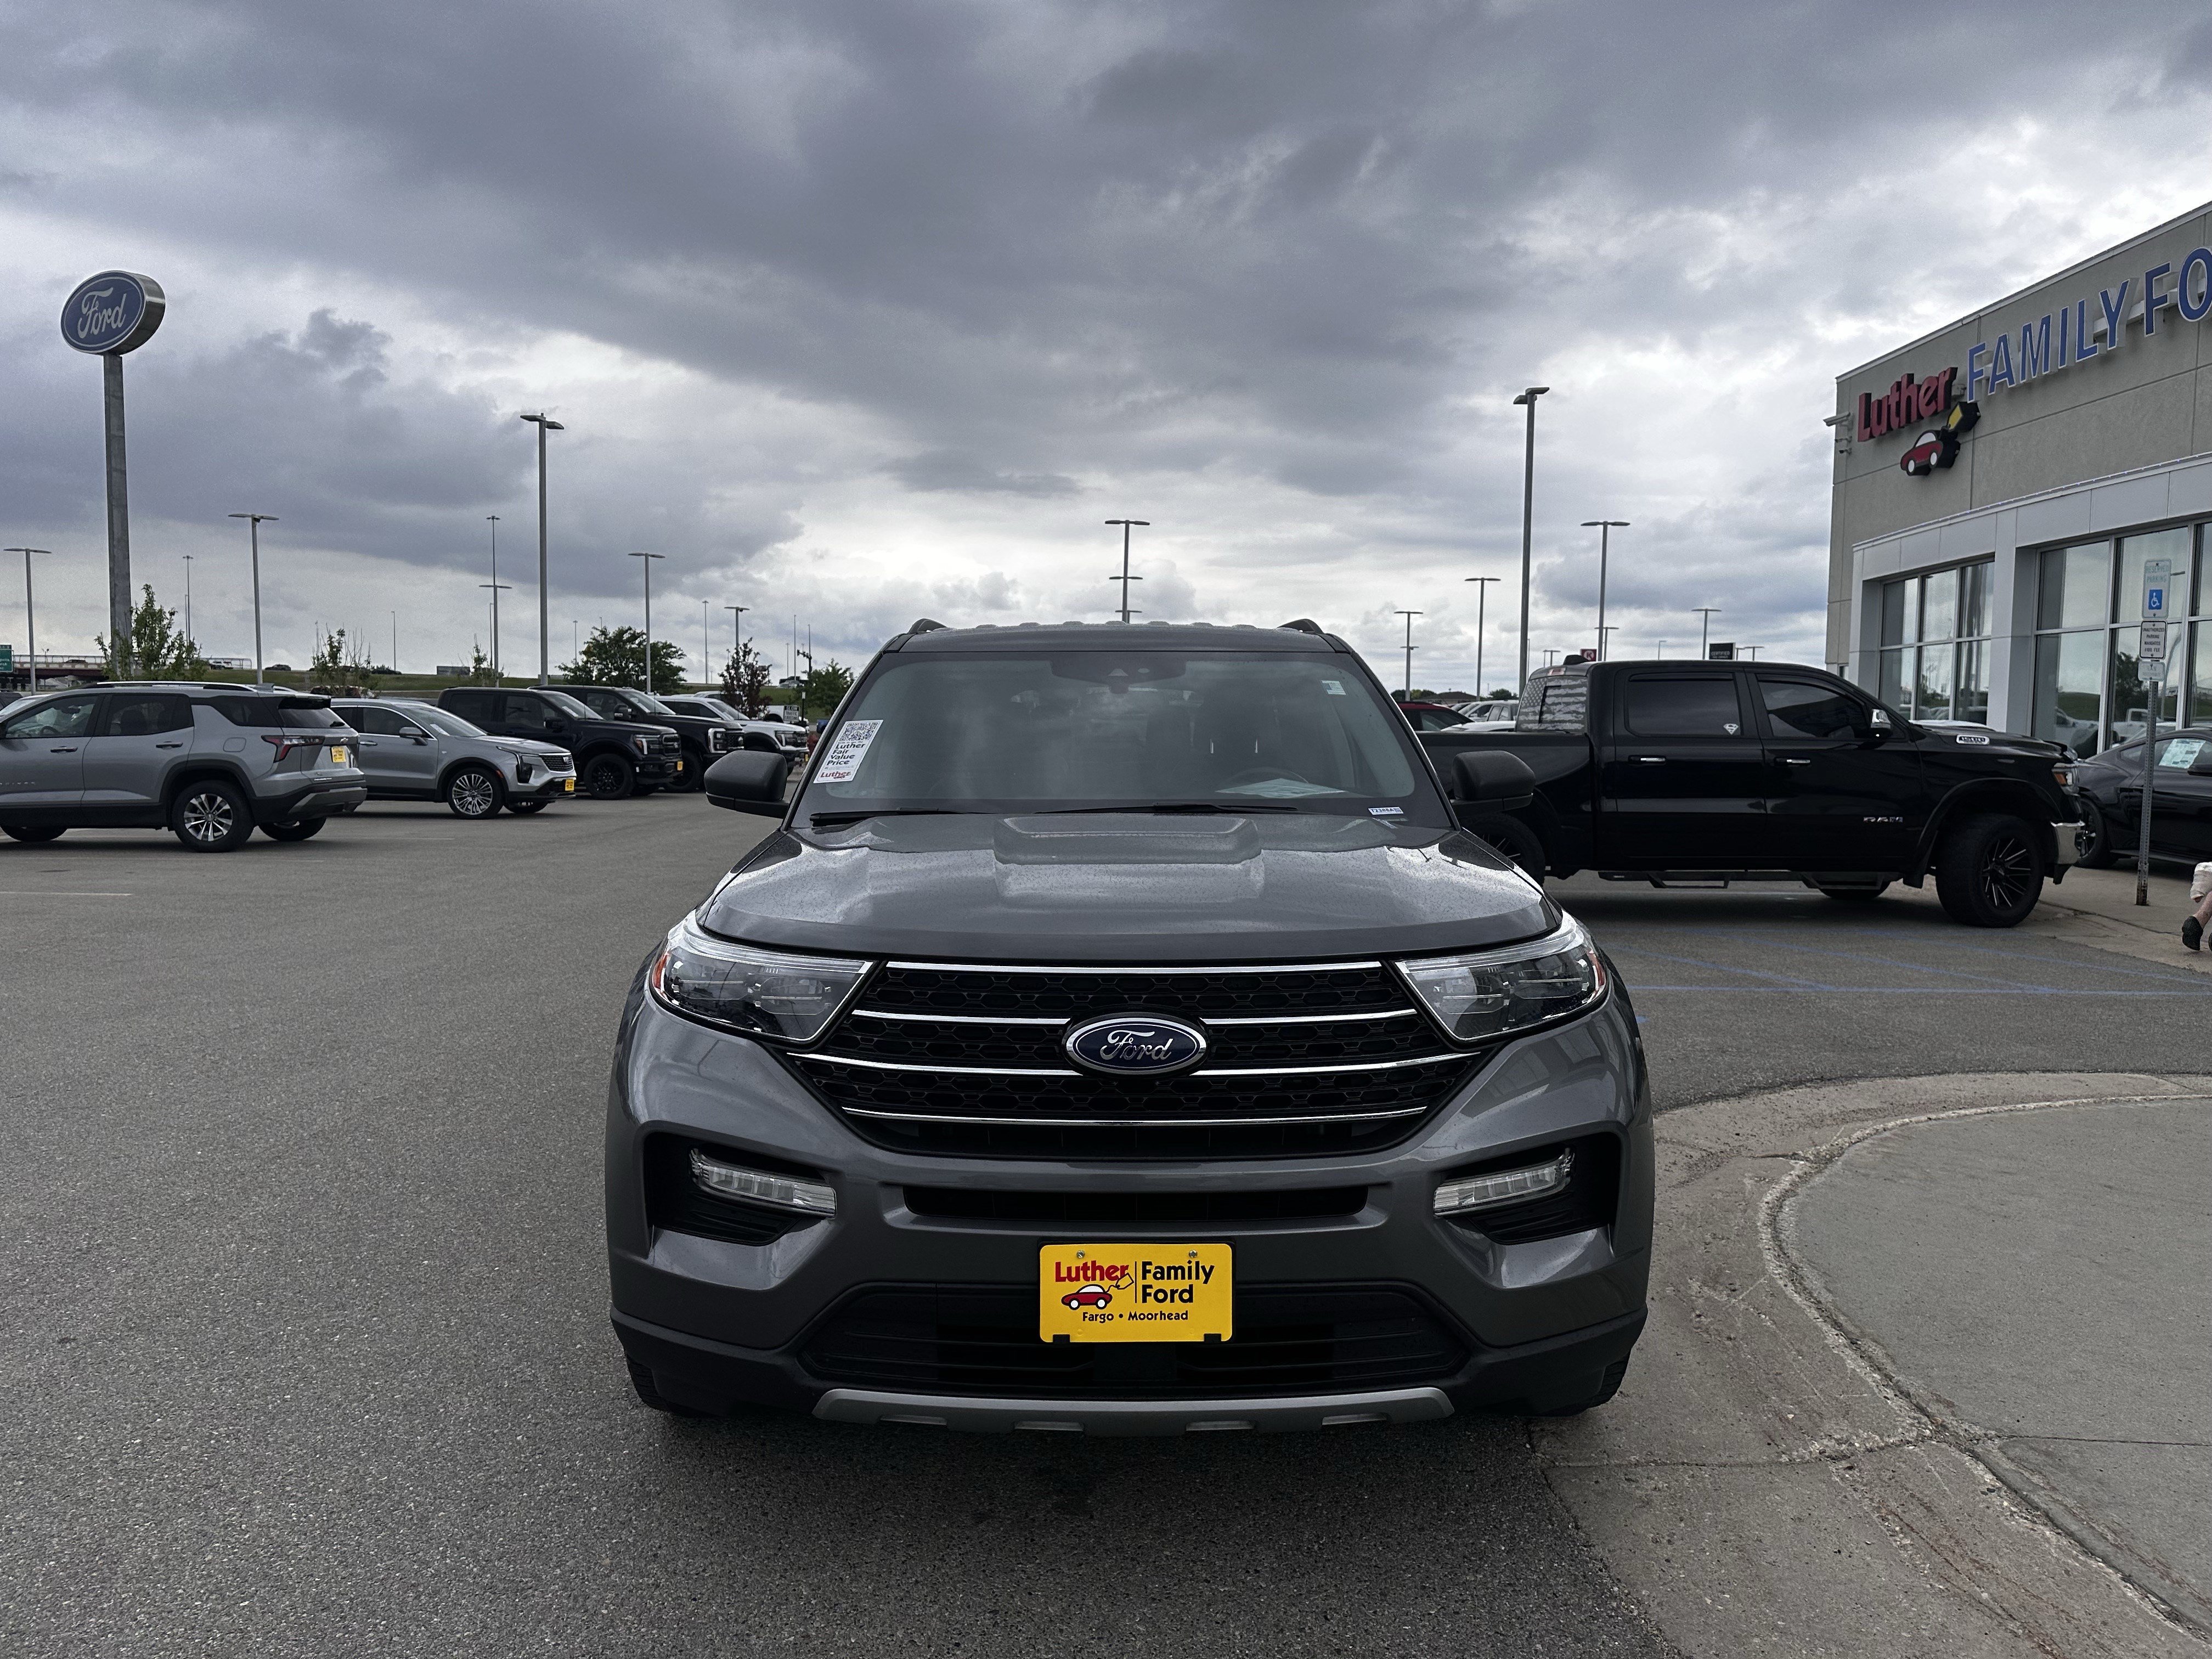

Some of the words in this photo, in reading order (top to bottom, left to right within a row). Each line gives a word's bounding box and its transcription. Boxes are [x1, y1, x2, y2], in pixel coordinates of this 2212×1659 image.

[78, 287, 127, 338] Ford
[1857, 366, 1958, 442] Luther
[1967, 279, 2134, 403] FAMILY
[1099, 1030, 1173, 1060] Ford
[1055, 1260, 1130, 1282] Luther
[1142, 1260, 1215, 1284] Family
[1142, 1284, 1193, 1304] Ford
[1082, 1312, 1114, 1323] Fargo
[1128, 1310, 1188, 1321] Moorhead
